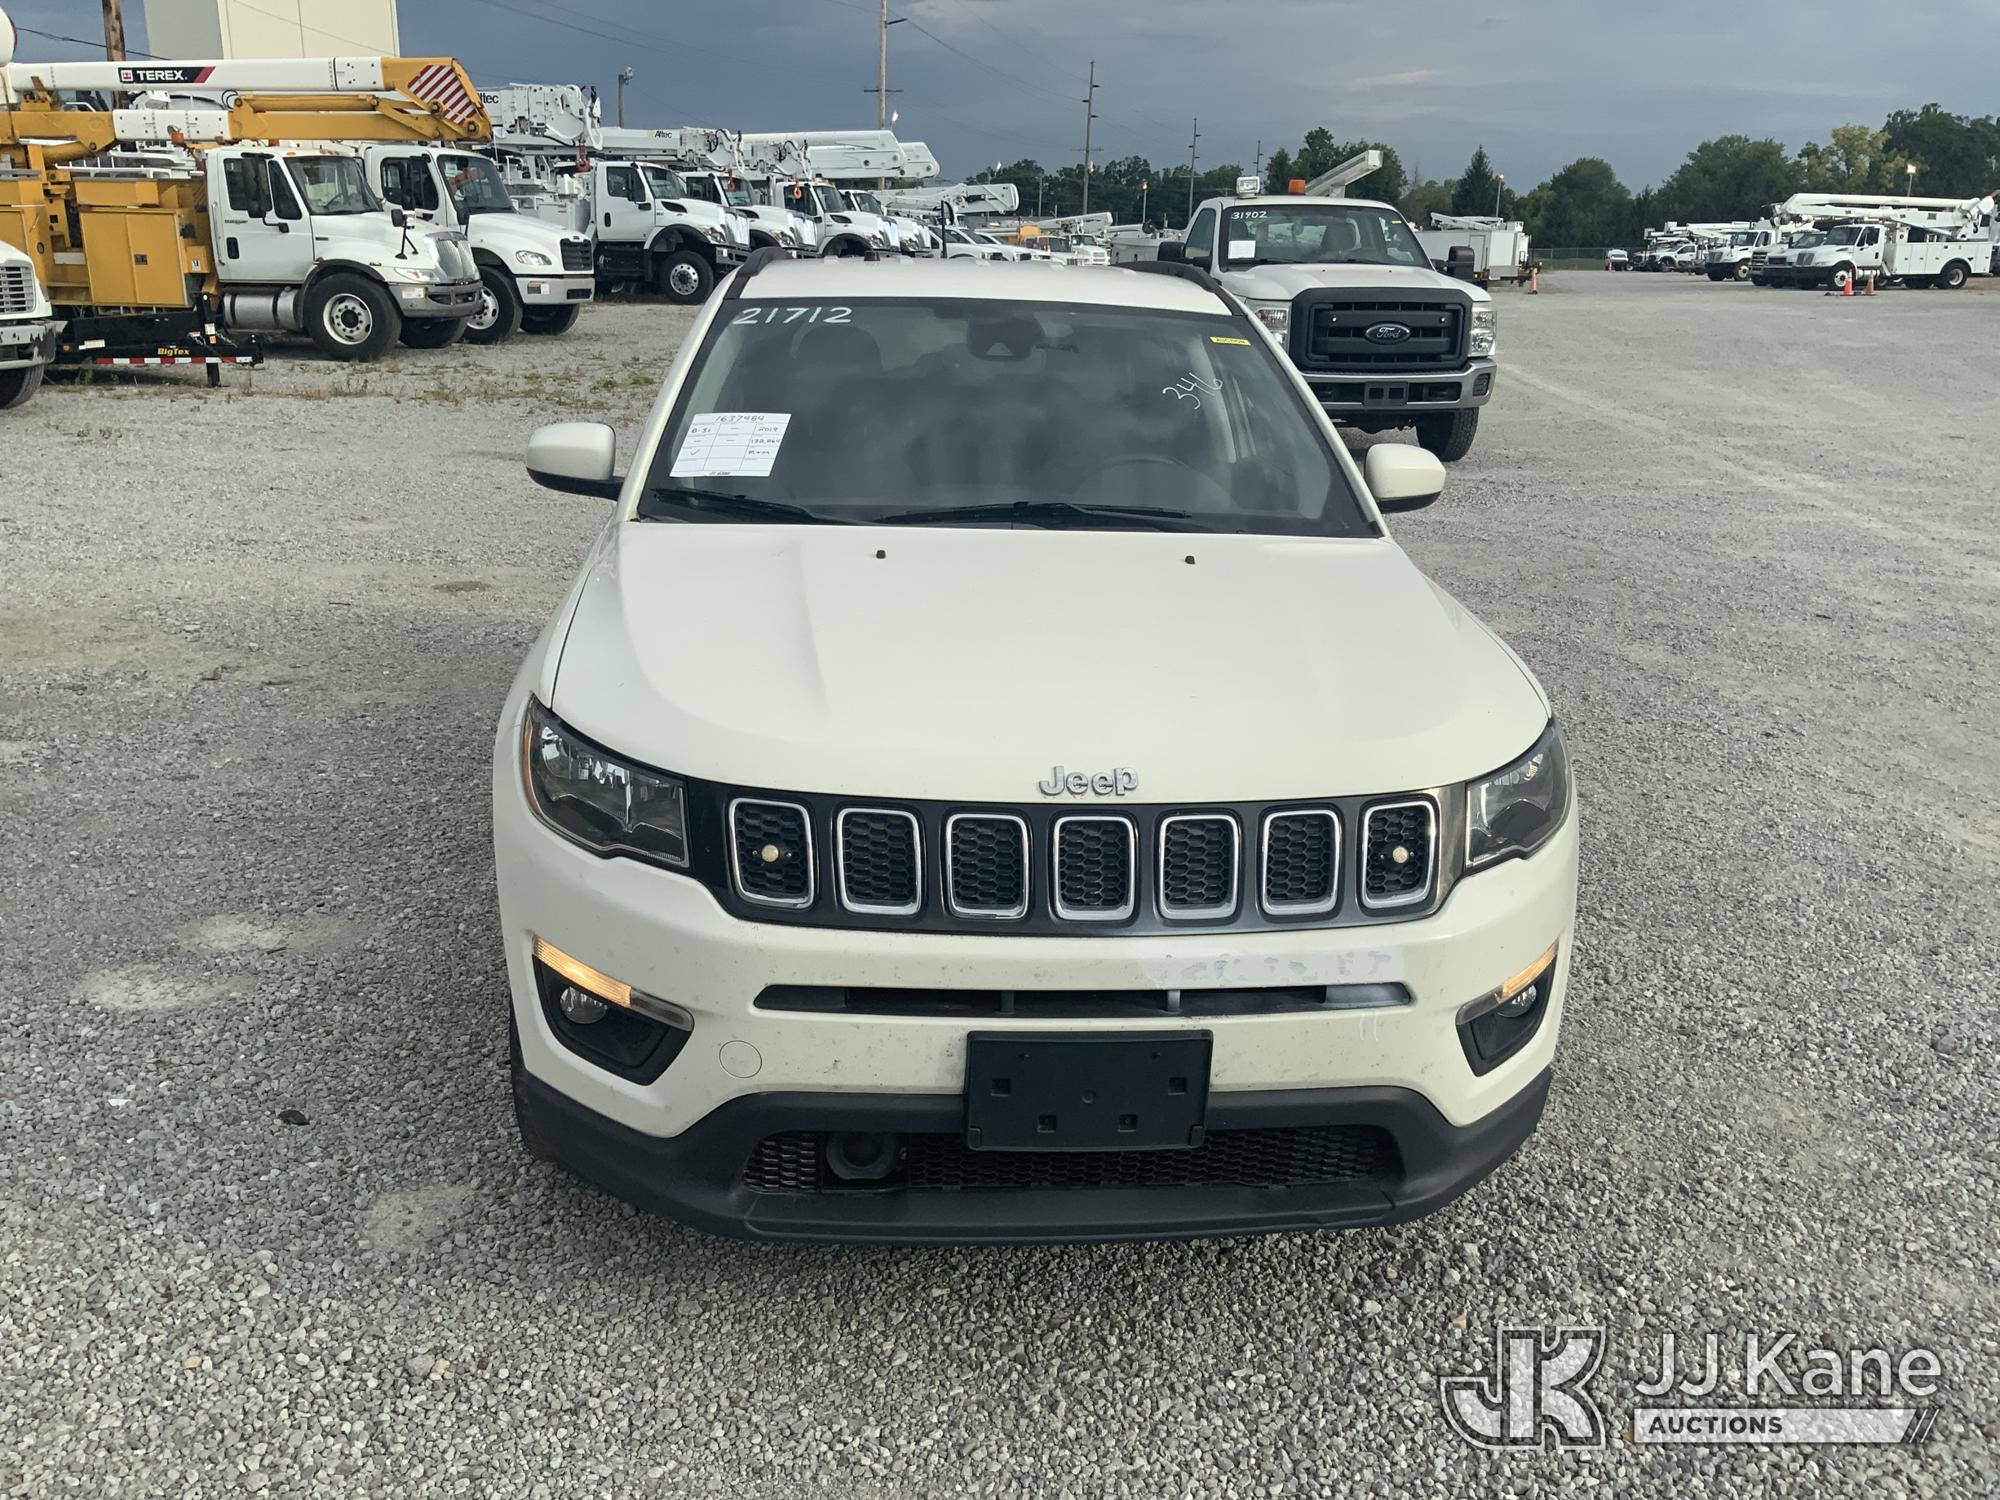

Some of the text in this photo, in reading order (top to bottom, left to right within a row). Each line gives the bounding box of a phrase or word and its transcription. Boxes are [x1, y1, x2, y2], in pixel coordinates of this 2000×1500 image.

[136, 69, 185, 81] TEREX
[479, 92, 499, 104] ltec
[654, 130, 673, 139] Altec
[1231, 210, 1268, 220] 31902
[732, 306, 853, 325] 21712
[1038, 765, 1138, 796] Jeep
